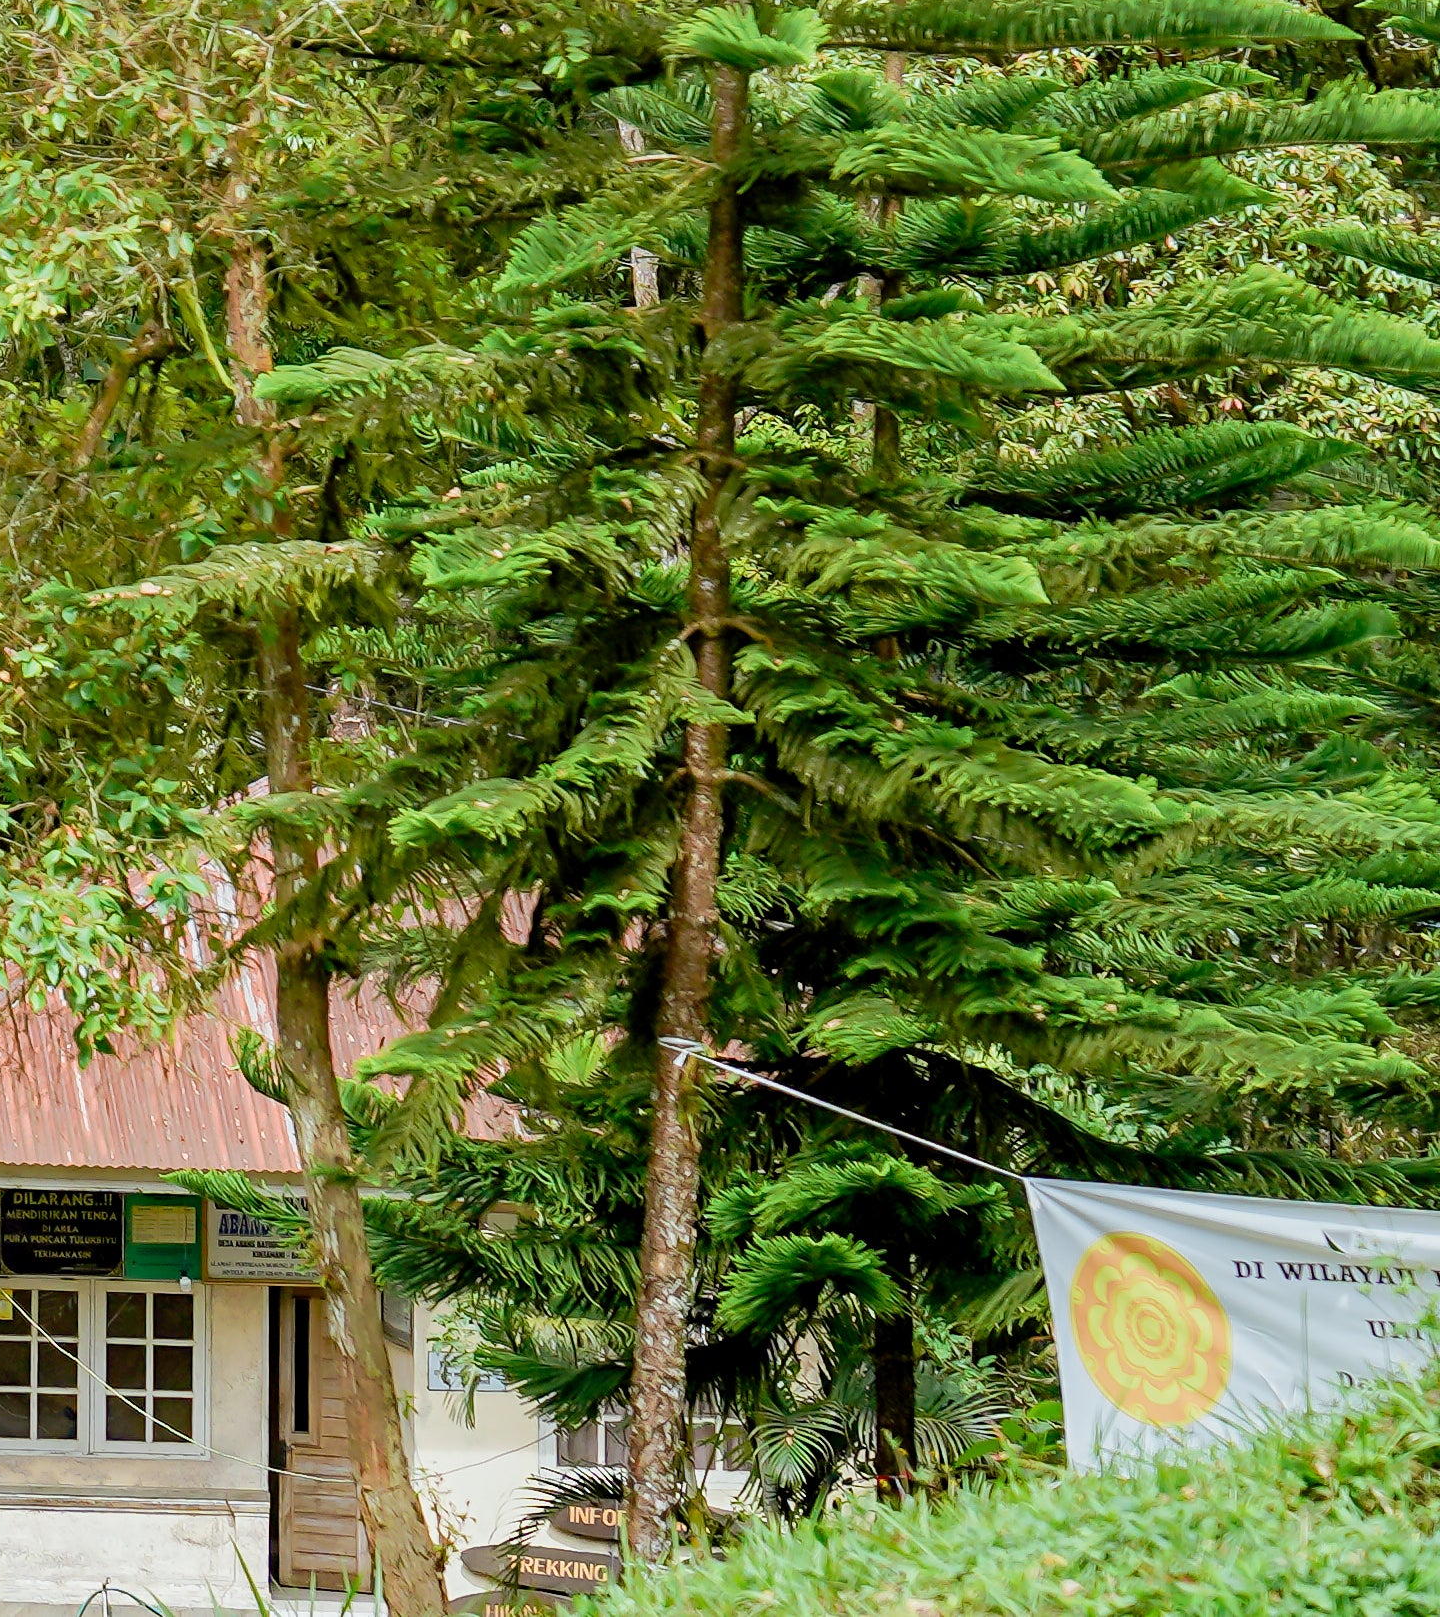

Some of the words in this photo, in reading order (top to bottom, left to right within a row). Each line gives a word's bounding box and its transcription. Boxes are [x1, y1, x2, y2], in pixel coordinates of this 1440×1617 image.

[6, 1209, 78, 1220] MENDIRIKAN
[81, 1210, 118, 1221] TENDA
[1232, 1260, 1266, 1279] DI
